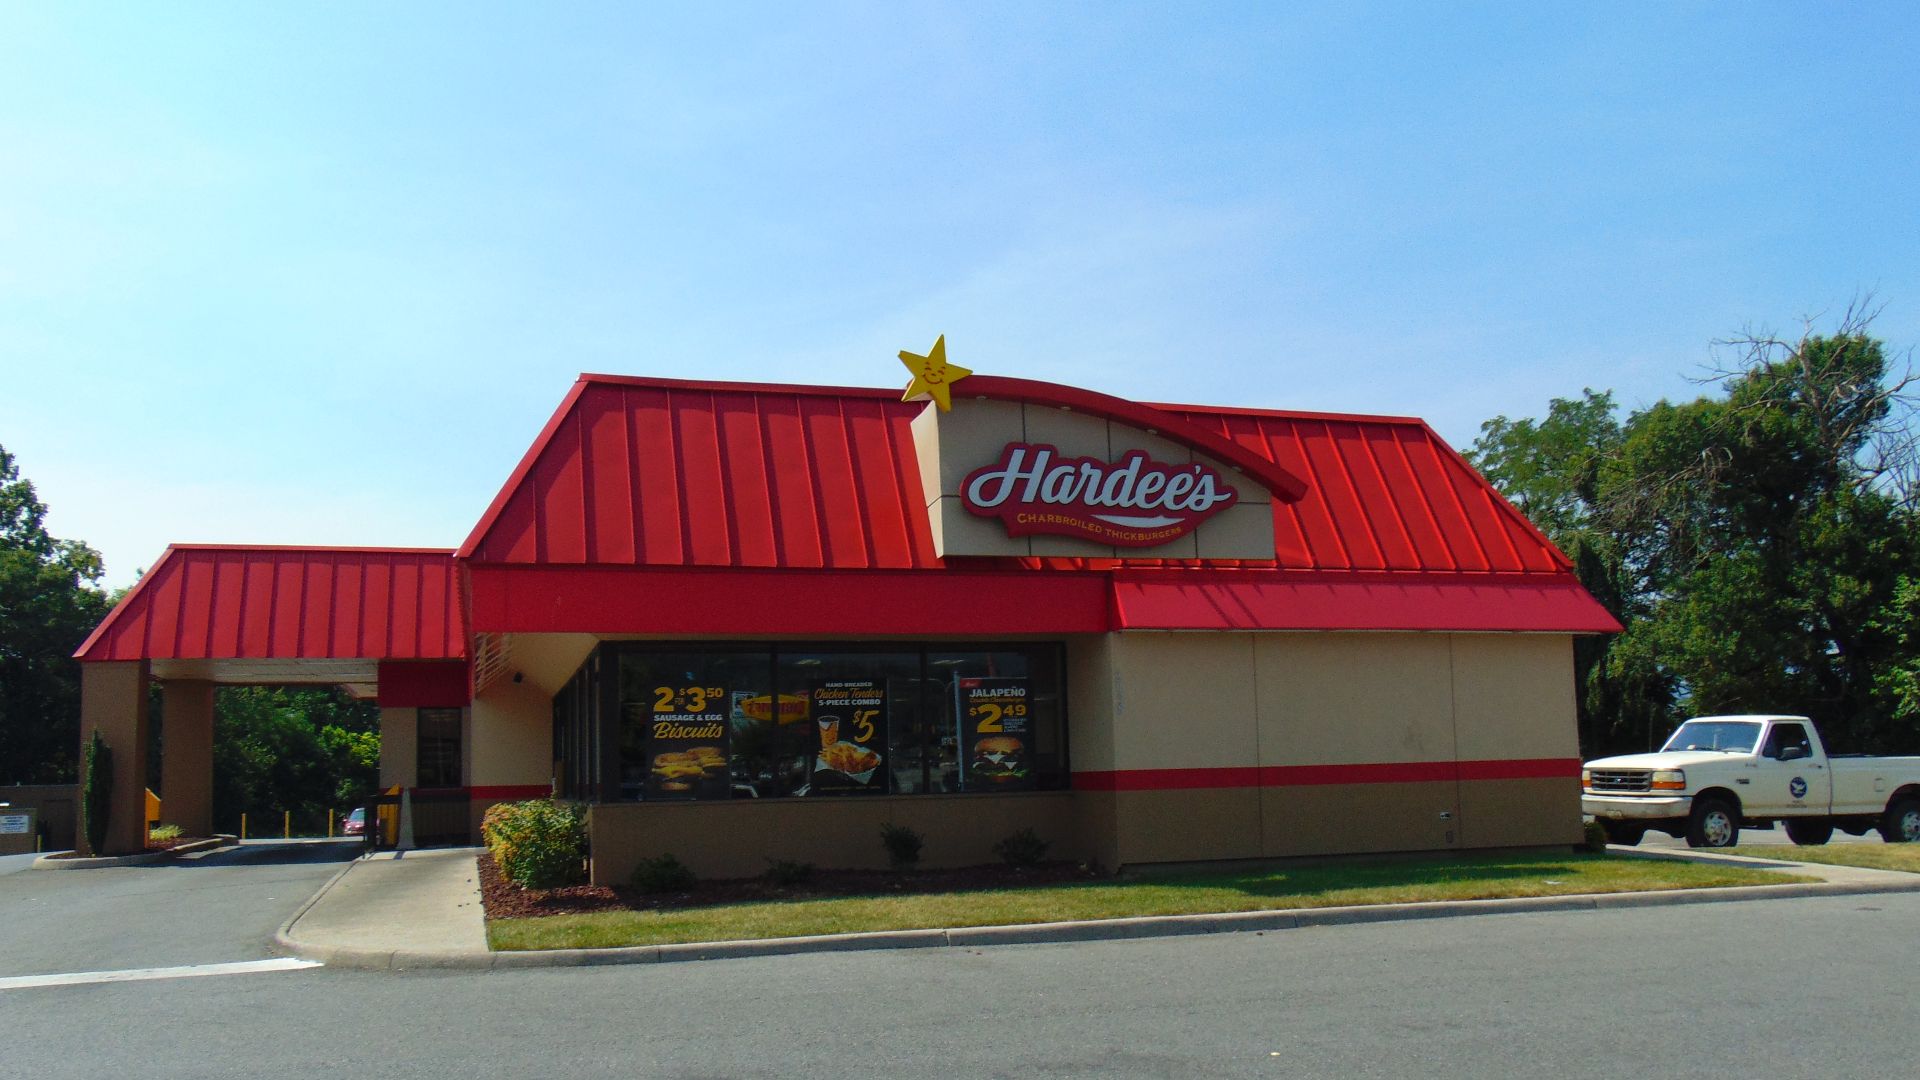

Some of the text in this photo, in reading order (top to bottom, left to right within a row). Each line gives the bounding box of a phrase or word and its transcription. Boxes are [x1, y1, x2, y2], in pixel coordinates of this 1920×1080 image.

[968, 449, 1231, 512] Hardee's
[1017, 513, 1182, 542] CHARBROILED THICKBURGERS
[653, 686, 675, 712] 2
[815, 687, 884, 700] Chicken Tenders
[969, 686, 1026, 698] JALAPEÑO
[653, 722, 724, 739] Biscuits
